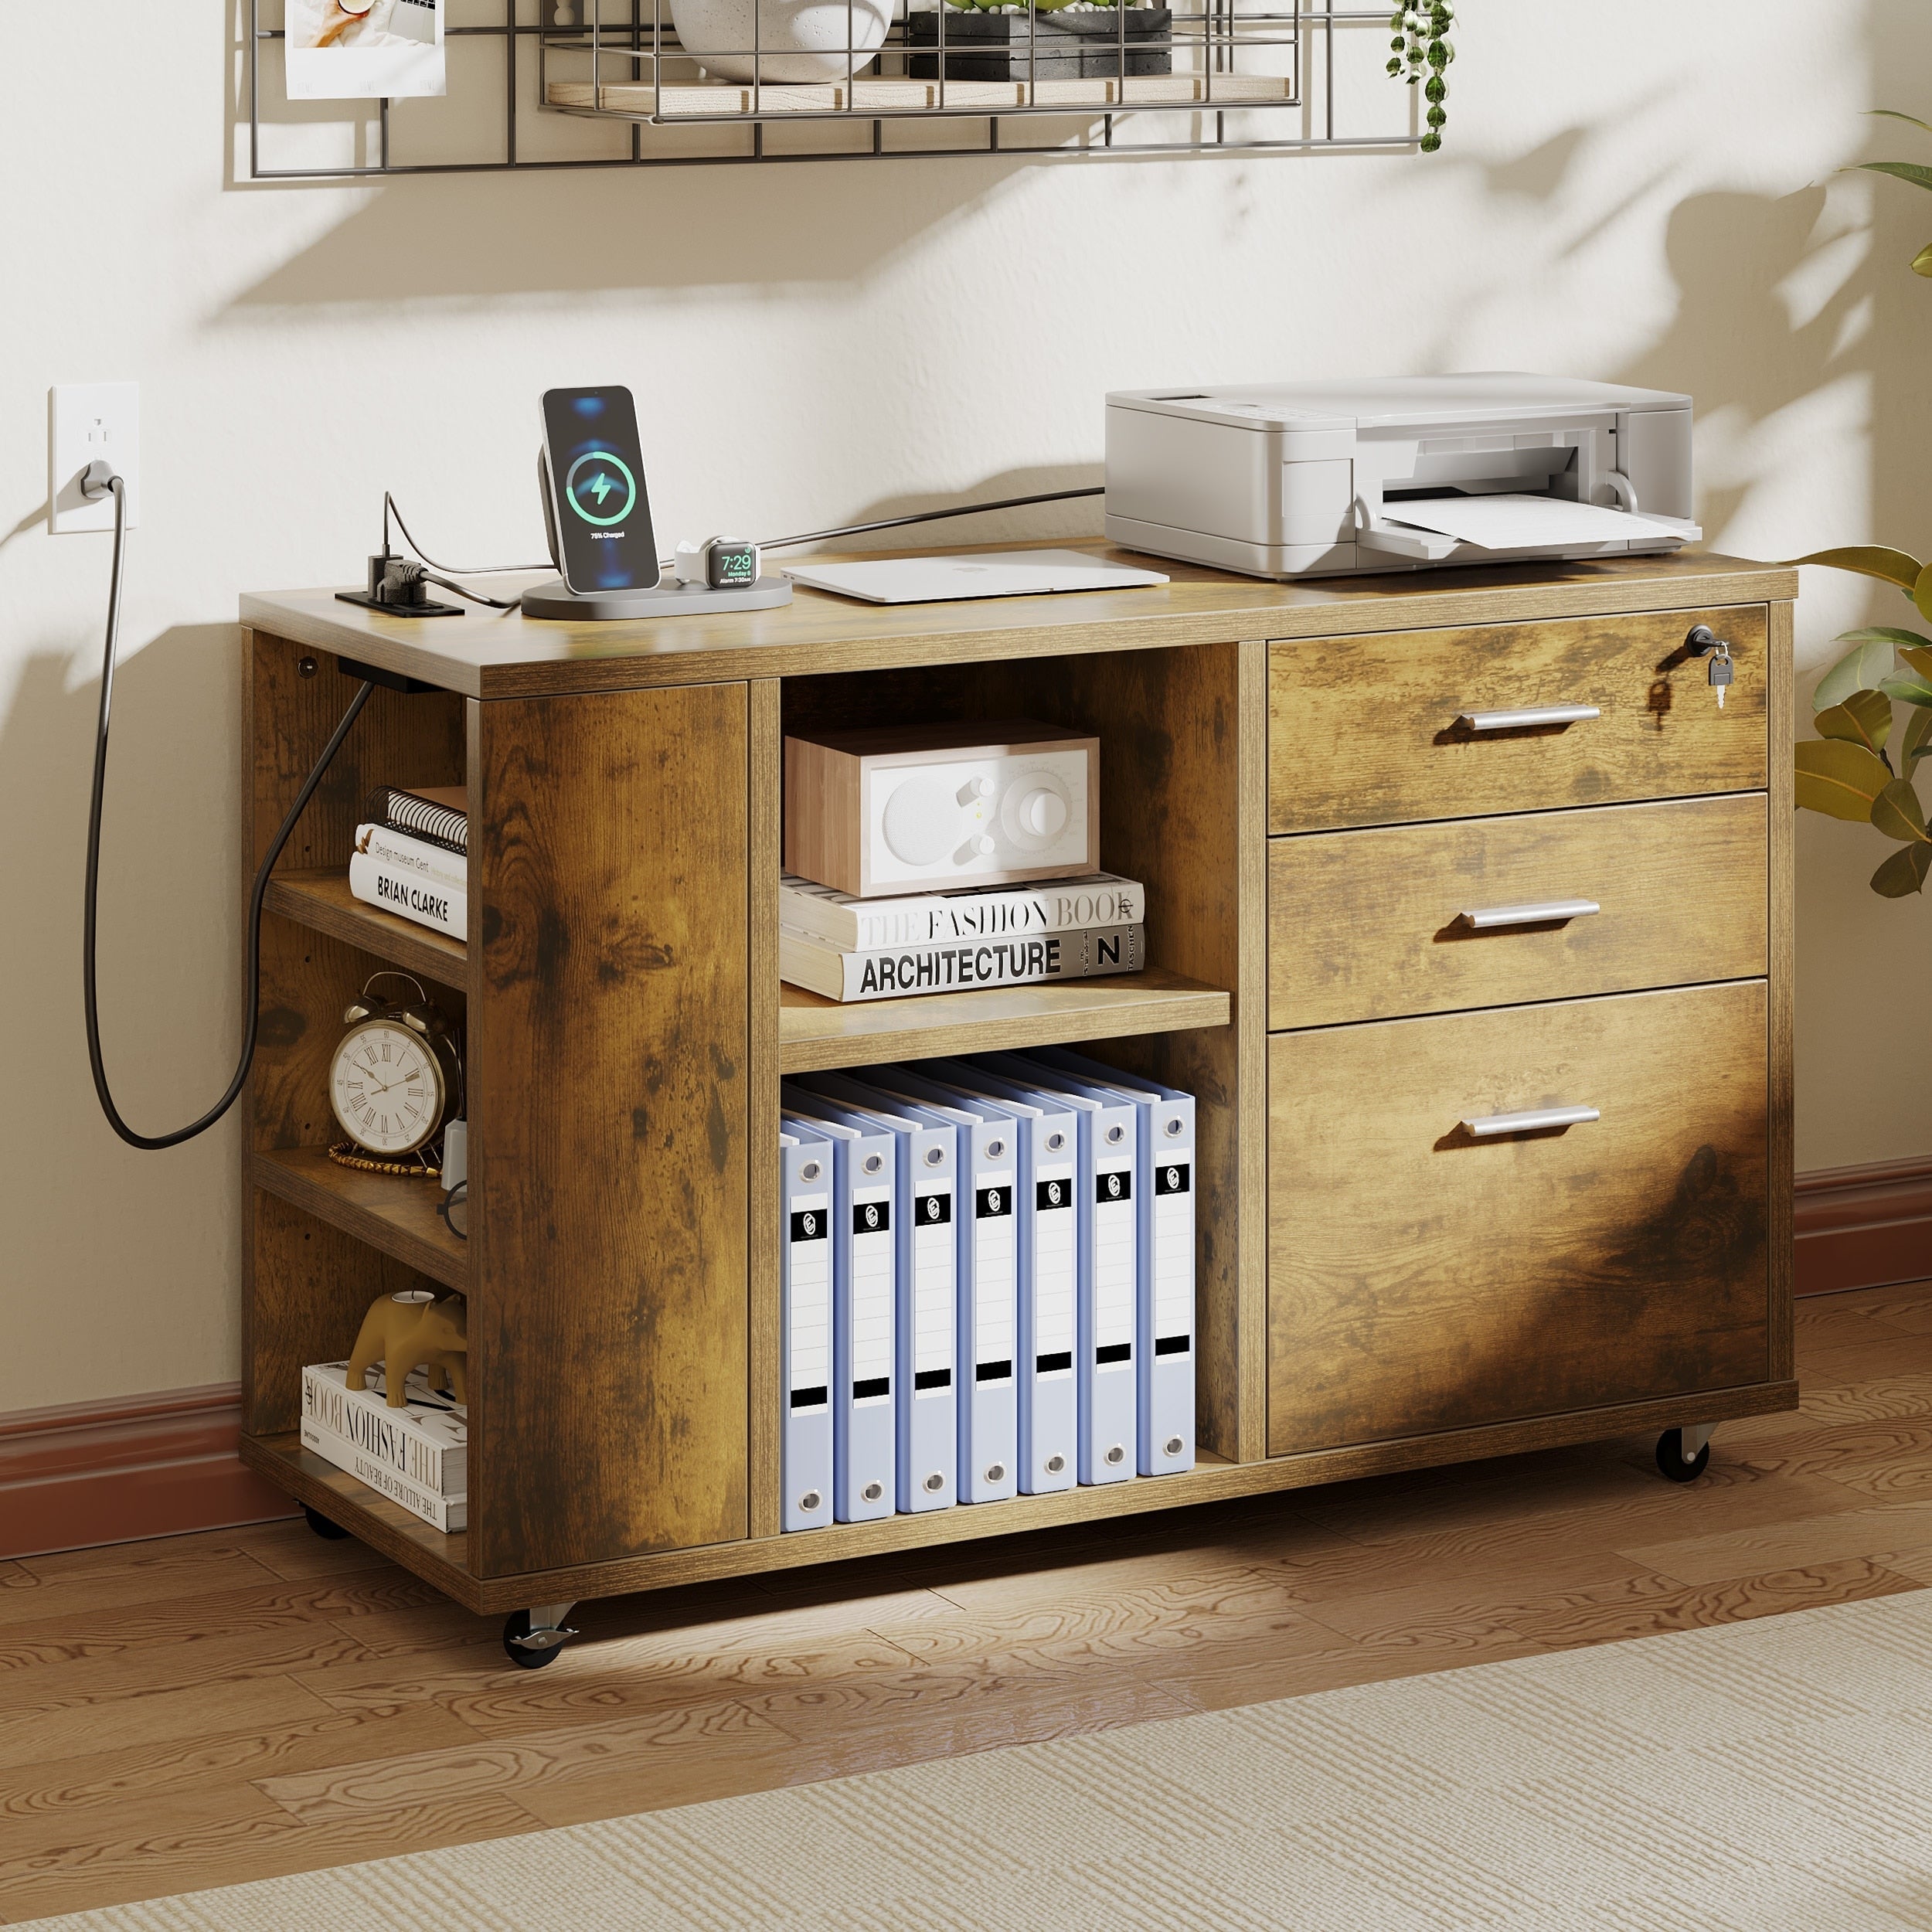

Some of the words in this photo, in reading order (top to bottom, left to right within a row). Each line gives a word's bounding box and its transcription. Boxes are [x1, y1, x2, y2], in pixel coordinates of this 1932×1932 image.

[721, 554, 752, 571] 7:29
[376, 842, 393, 862] Design
[393, 852, 415, 867] museum
[378, 876, 409, 906] BRIAN
[411, 889, 448, 922] CLARKE
[861, 912, 920, 946] THE
[928, 899, 1049, 940] FASHION
[1057, 890, 1134, 927] BOOK
[859, 938, 1062, 994] ARCHITECTURE
[381, 1043, 391, 1063] XII
[304, 1375, 342, 1434] BOOK
[346, 1401, 406, 1472] FASHION
[354, 1456, 383, 1486] BEAUTY
[409, 1437, 440, 1492] THE
[383, 1471, 393, 1493] OF
[393, 1480, 421, 1510] ALLURE
[422, 1498, 437, 1521] THE
